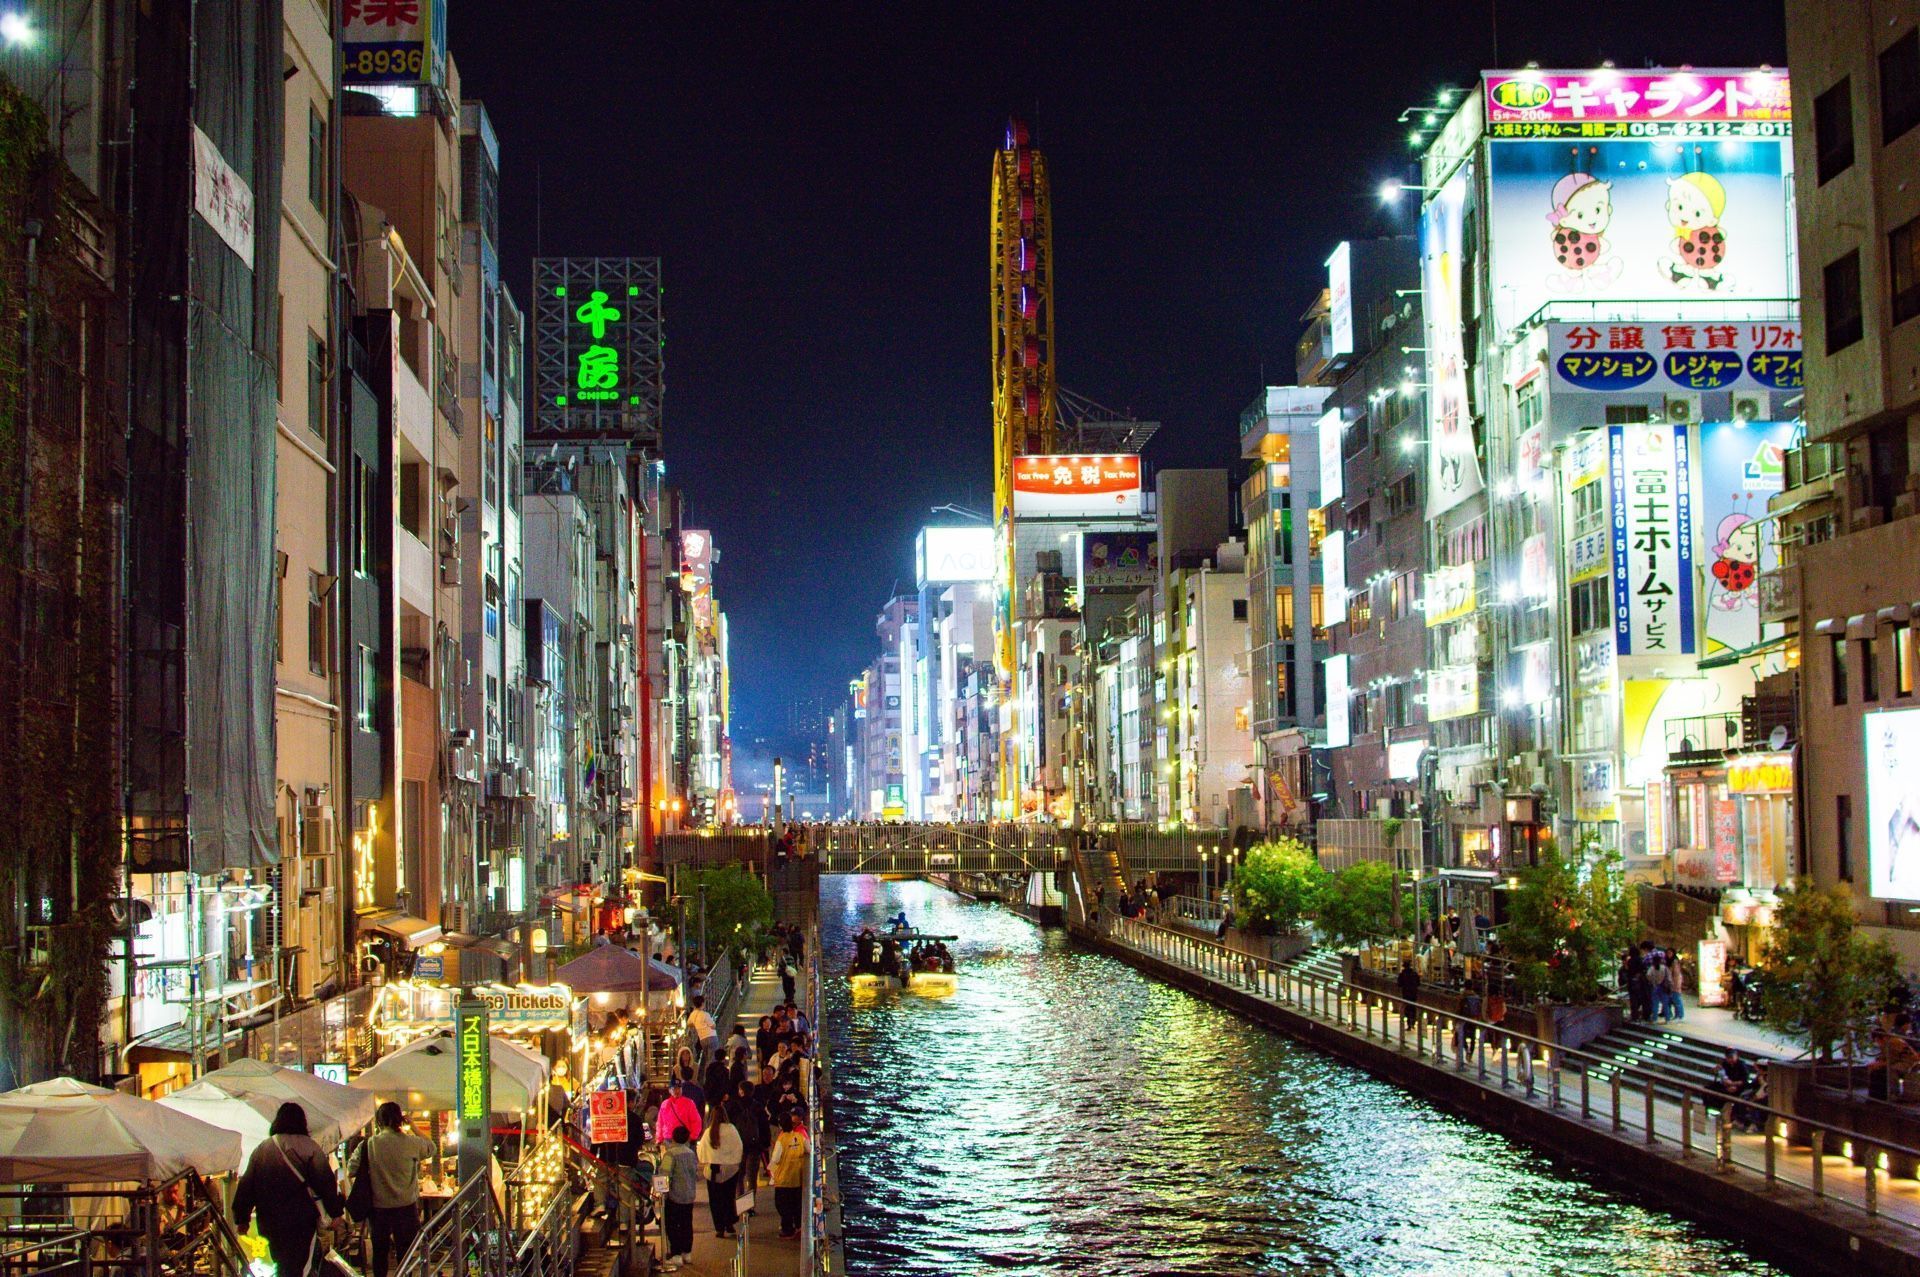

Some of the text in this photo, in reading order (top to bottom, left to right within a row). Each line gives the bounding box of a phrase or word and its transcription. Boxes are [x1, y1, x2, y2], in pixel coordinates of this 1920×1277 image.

[576, 291, 620, 389] 千房
[1566, 326, 1644, 350] 分譲
[1661, 325, 1739, 350] 賃貸
[1564, 357, 1653, 377] マンション
[1671, 356, 1740, 376] レジャー
[1691, 377, 1722, 388] ビル
[577, 391, 639, 400] CHIBO
[1104, 471, 1118, 479] Tax
[1632, 469, 1673, 650] 富士ホームサービス
[507, 992, 565, 1011] Tickets
[606, 1098, 614, 1110] 3
